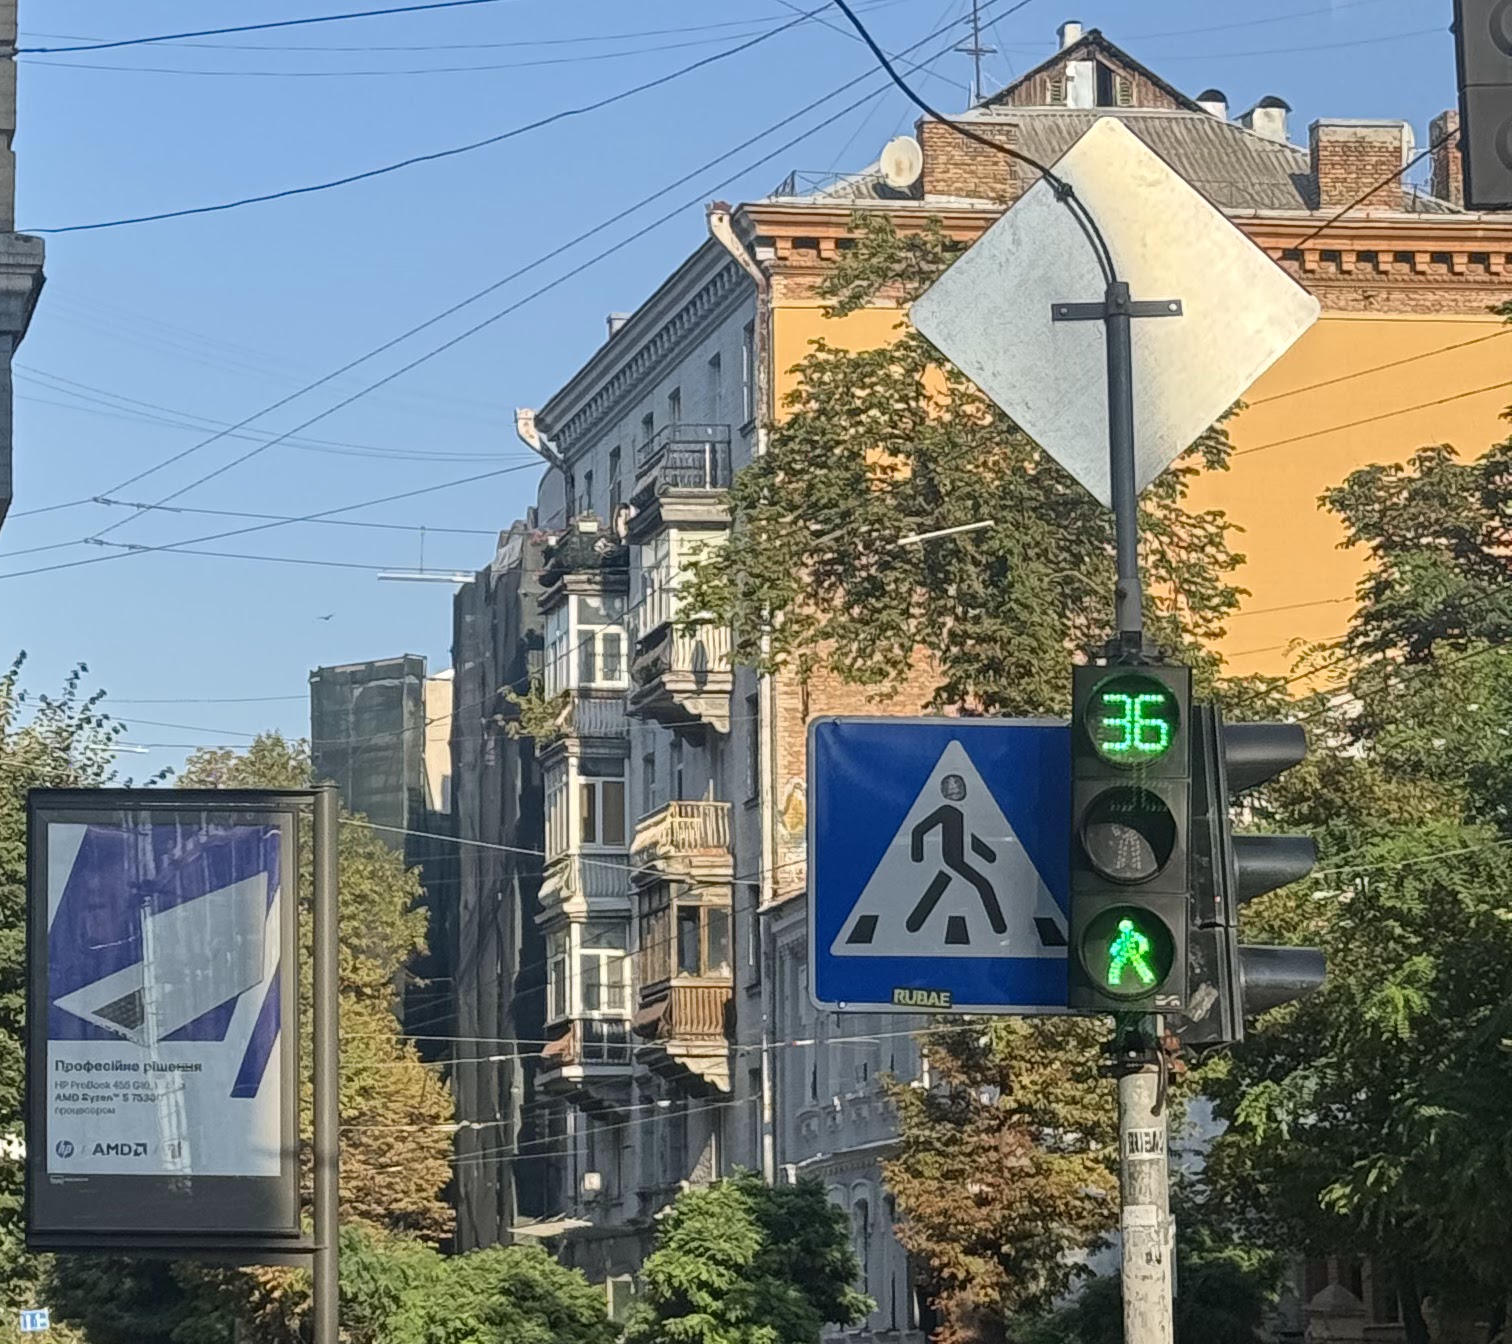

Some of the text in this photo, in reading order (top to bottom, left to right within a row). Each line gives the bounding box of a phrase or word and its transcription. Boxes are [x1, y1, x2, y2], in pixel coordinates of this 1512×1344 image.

[1102, 693, 1169, 753] 36
[894, 989, 951, 1006] RUBAE
[55, 1060, 139, 1073] Професійне
[92, 1143, 133, 1156] AMD
